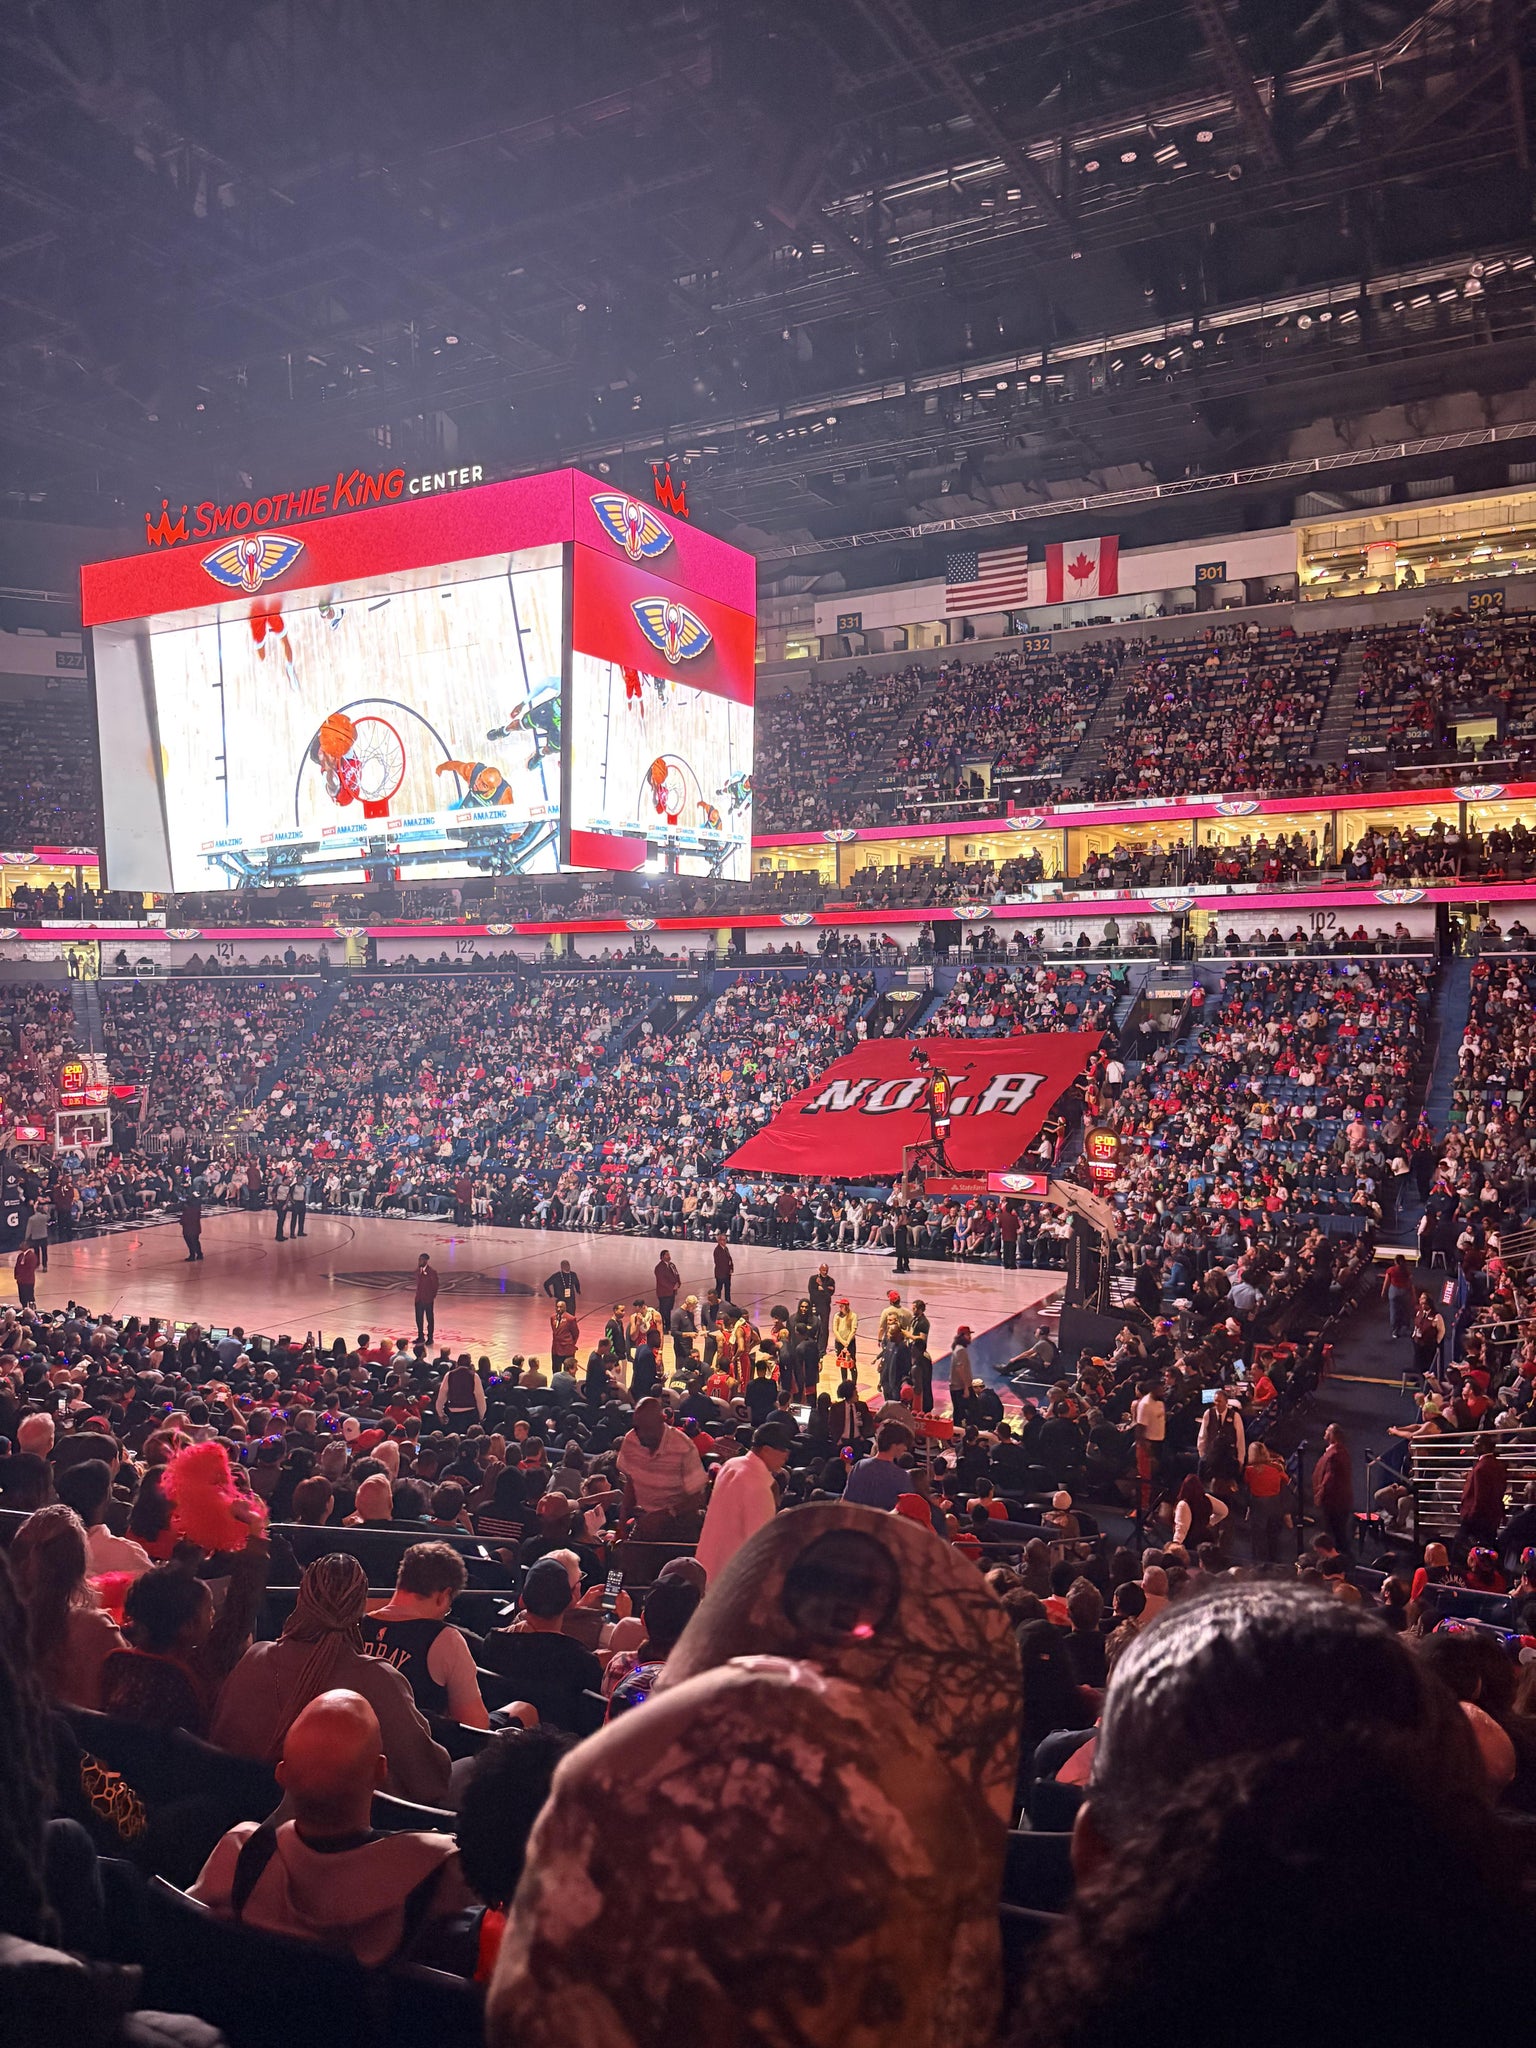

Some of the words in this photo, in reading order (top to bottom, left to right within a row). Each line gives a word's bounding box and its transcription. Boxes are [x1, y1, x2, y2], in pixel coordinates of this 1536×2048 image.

[409, 465, 484, 494] CENTER
[1198, 564, 1223, 581] 301
[839, 615, 860, 629] 331
[1024, 637, 1050, 652] 332
[57, 654, 83, 667] 327
[403, 816, 436, 828] AMAZING
[473, 809, 508, 821] AMAZING
[274, 831, 304, 841] AMAZING
[336, 824, 368, 835] AMAZING
[215, 837, 243, 848] AMAZING
[1309, 911, 1336, 930] 102
[456, 940, 475, 953] 122
[633, 934, 650, 949] 13
[216, 943, 234, 957] 121
[801, 1073, 1048, 1116] NOLA
[1095, 1136, 1117, 1146] 12:00
[1095, 1145, 1111, 1157] 24
[7, 1212, 19, 1227] G
[735, 1404, 748, 1419] G
